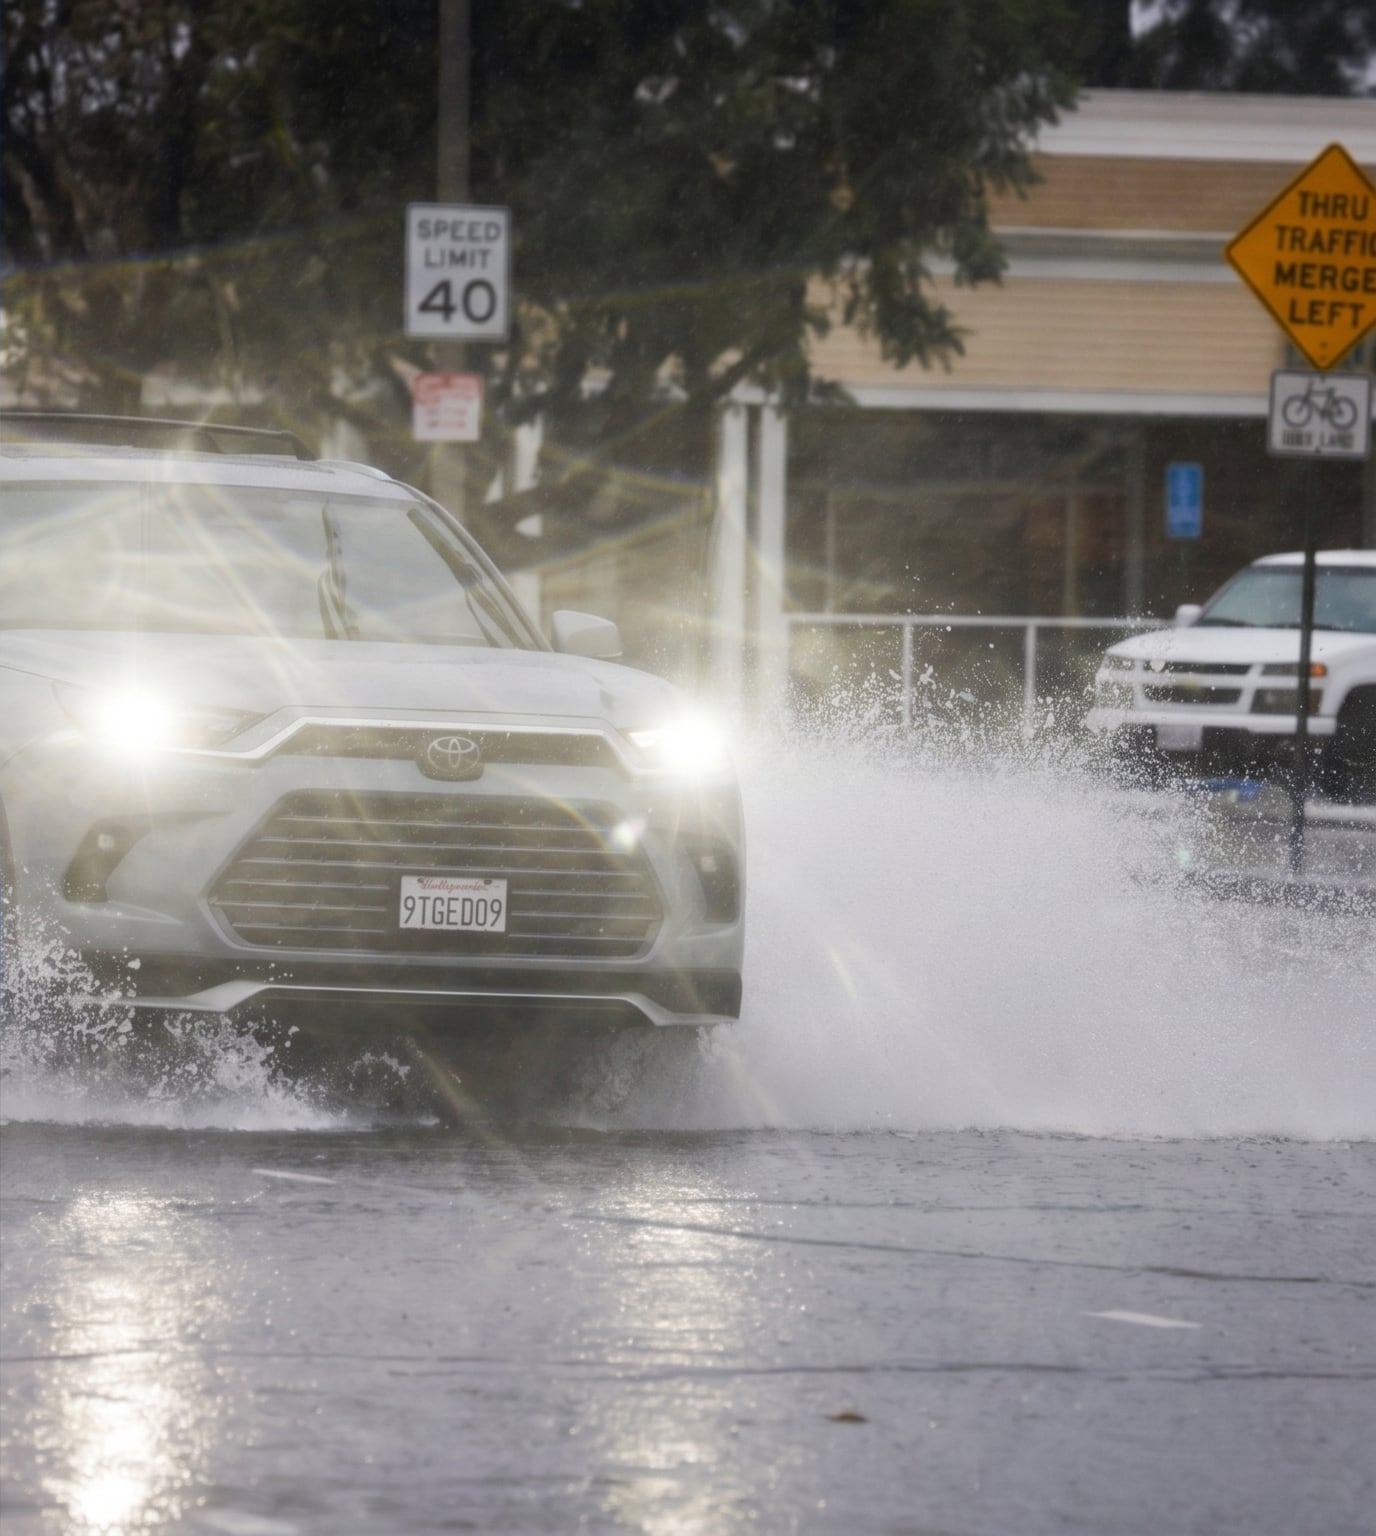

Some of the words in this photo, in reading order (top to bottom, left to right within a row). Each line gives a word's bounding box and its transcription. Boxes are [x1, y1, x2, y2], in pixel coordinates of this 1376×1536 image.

[1298, 190, 1369, 222] THRU
[417, 218, 501, 243] SPEED
[424, 247, 492, 270] LIMIT
[1274, 261, 1376, 294] MERGE
[417, 278, 497, 325] 40
[1289, 299, 1365, 329] LEFT
[403, 895, 503, 927] 9TGED09
